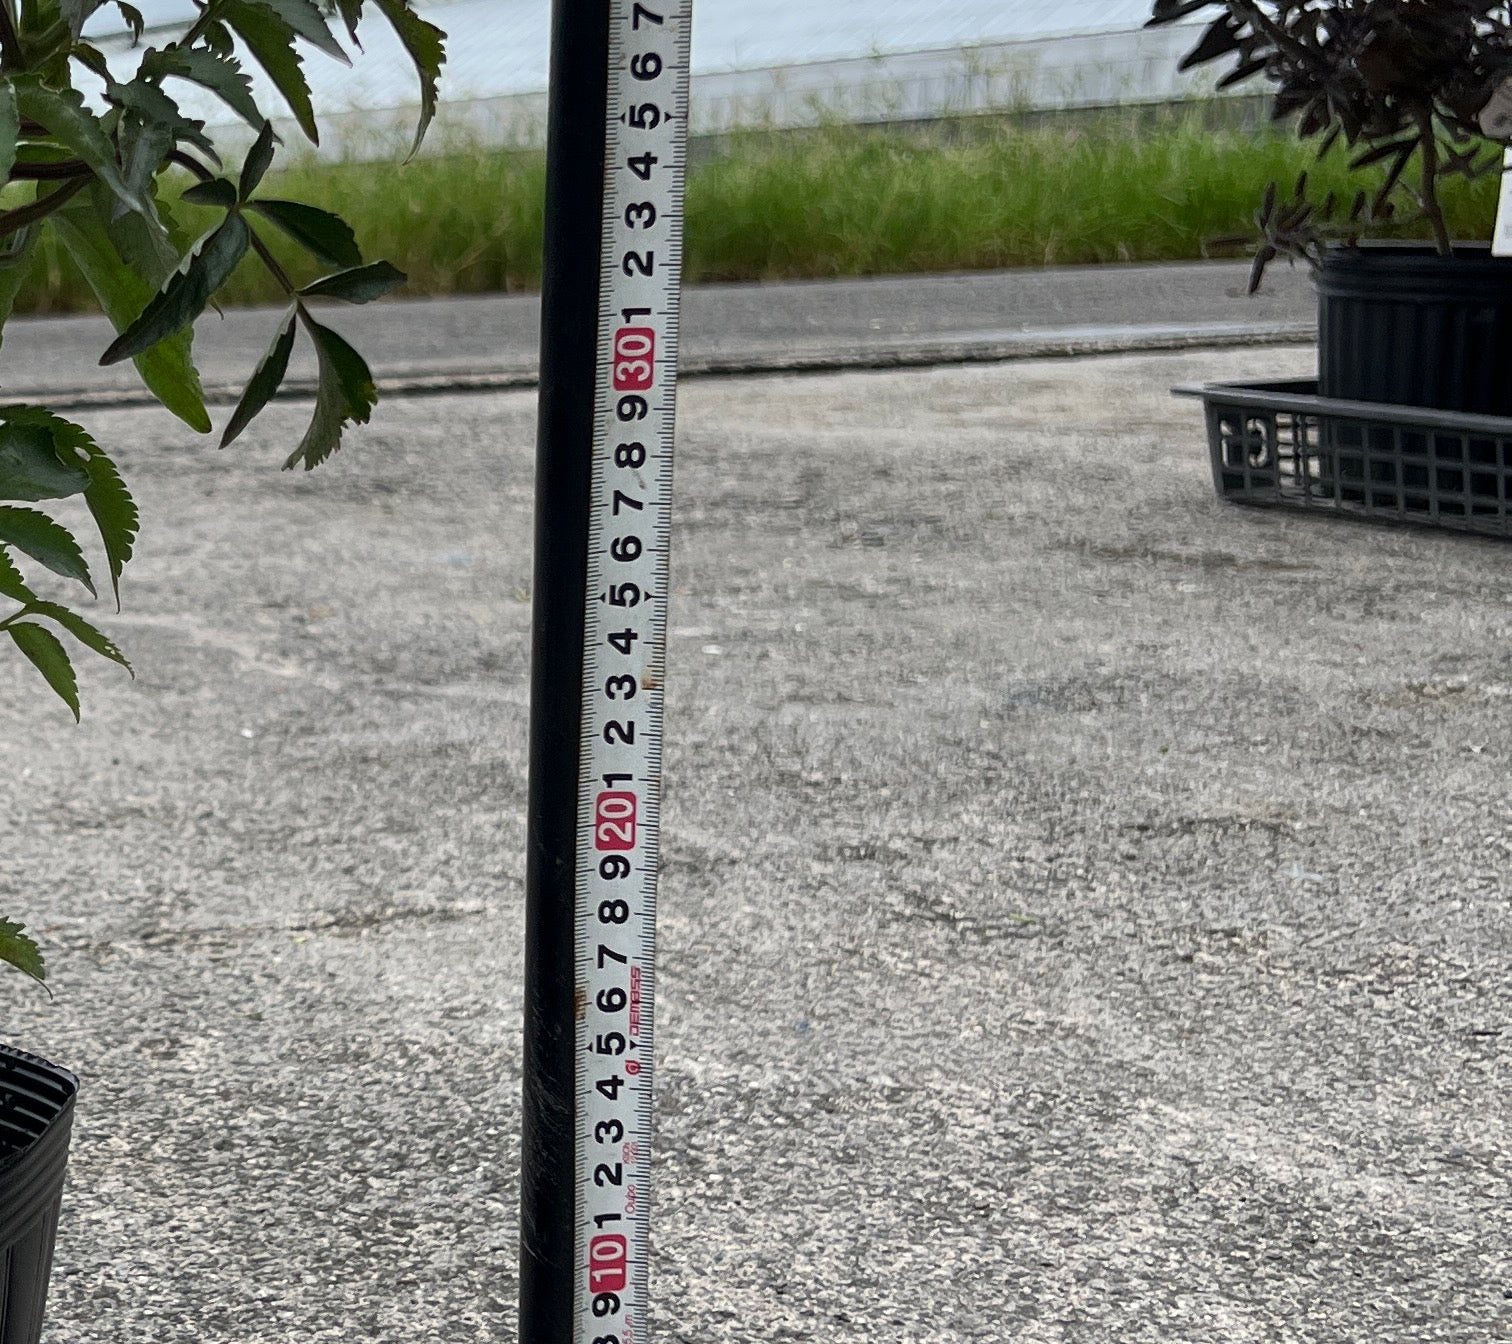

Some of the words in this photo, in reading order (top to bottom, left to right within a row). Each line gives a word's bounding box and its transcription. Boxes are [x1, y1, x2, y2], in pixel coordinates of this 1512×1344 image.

[632, 2, 664, 31] 7
[630, 52, 663, 81] 6
[628, 102, 661, 130] 5
[627, 151, 658, 181] 4
[624, 201, 657, 230] 3
[622, 250, 654, 278] 2
[621, 307, 652, 324] 1
[616, 334, 652, 382] 30
[616, 394, 648, 422] 9
[614, 441, 647, 469] 8
[612, 489, 644, 516] 7
[610, 535, 643, 563] 6
[608, 582, 641, 608] 5
[607, 627, 638, 655] 4
[605, 674, 637, 701] 3
[603, 719, 635, 745] 2
[602, 773, 633, 789] 1
[598, 797, 634, 843] 20
[599, 854, 631, 881] 9
[597, 899, 630, 925] 8
[597, 944, 628, 969] 7
[596, 987, 627, 1013] 6
[596, 1031, 626, 1056] 5
[595, 1074, 625, 1101] 4
[594, 1118, 624, 1144] 3
[593, 1162, 623, 1187] 2
[593, 1213, 622, 1229] 1
[591, 1240, 624, 1283] 10
[591, 1291, 621, 1318] 9
